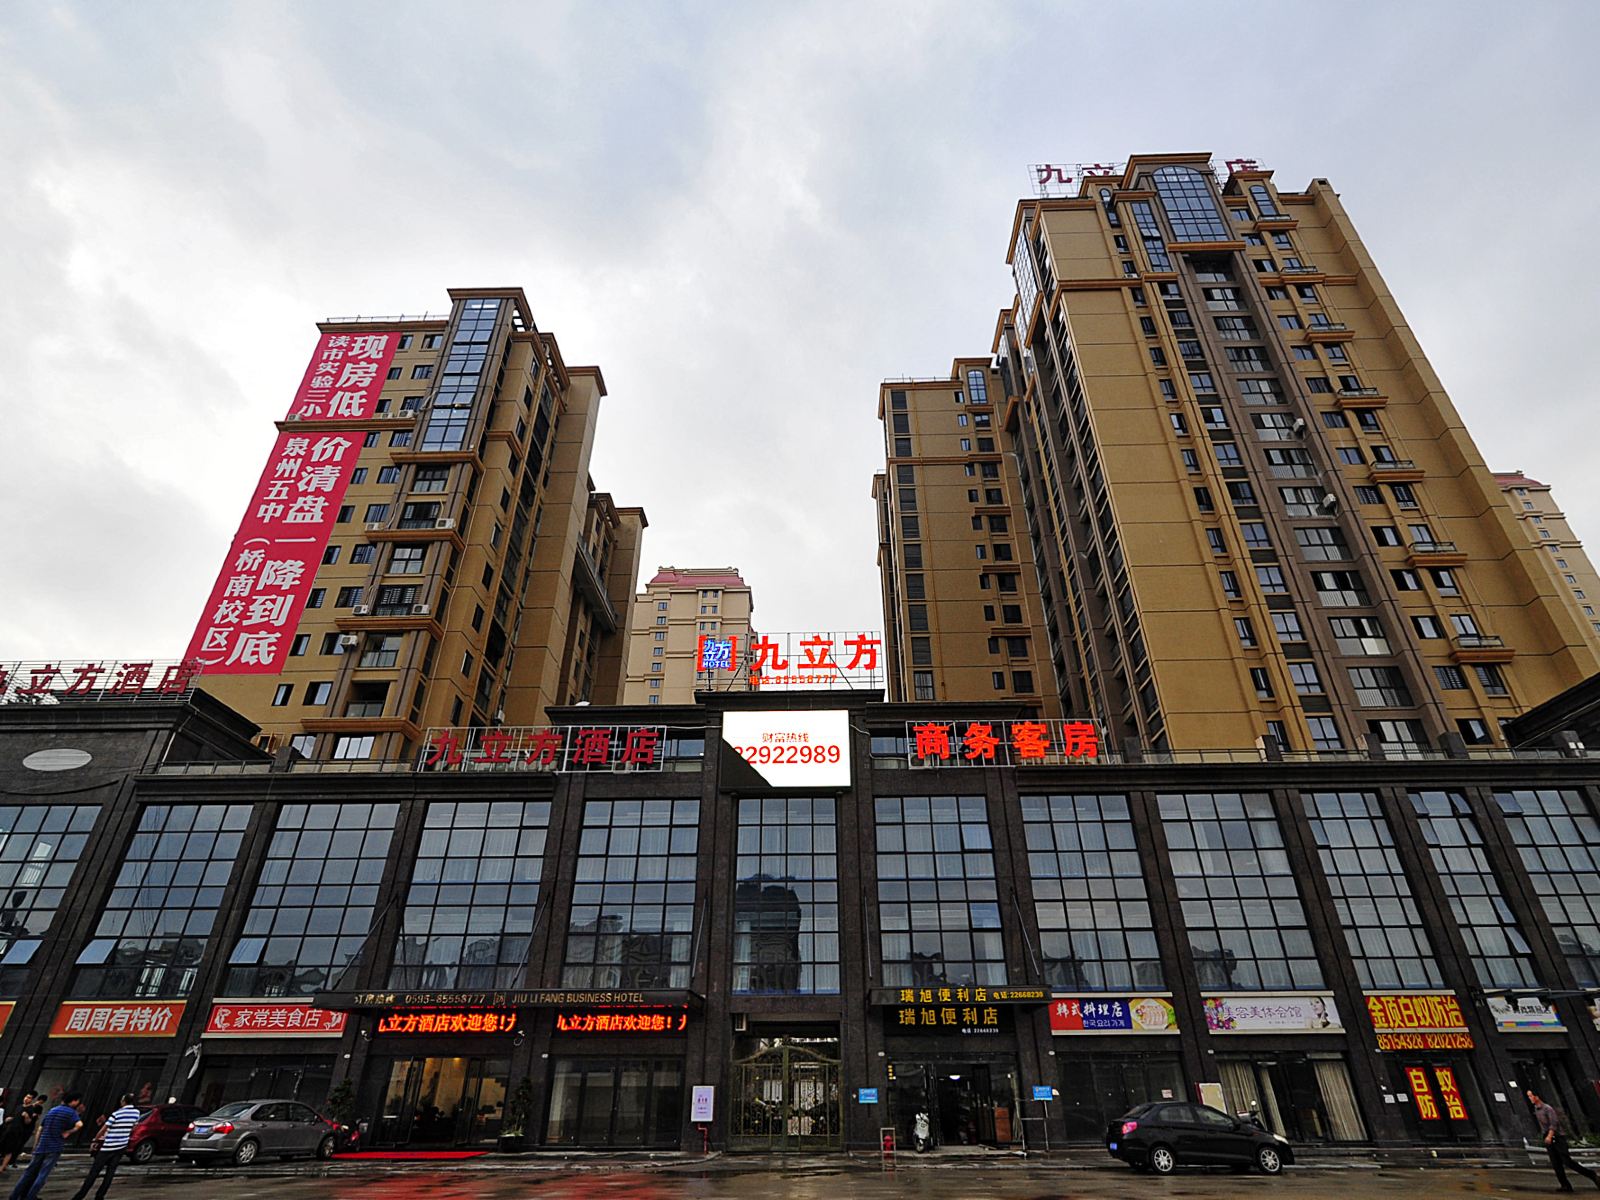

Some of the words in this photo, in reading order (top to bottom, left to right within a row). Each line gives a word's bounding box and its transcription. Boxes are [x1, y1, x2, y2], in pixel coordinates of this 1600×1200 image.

[749, 634, 882, 672] 九立方
[702, 660, 731, 668] HOTEL
[427, 729, 660, 766] 九立方酒店
[912, 721, 1100, 760] 商务客房
[512, 993, 527, 1004] JIU
[530, 993, 538, 1004] LI
[540, 993, 565, 1004] FANG
[567, 992, 612, 1003] BUSINESS
[614, 992, 645, 1003] HOTEL
[900, 987, 988, 1003] 瑞旭便利店
[233, 1008, 323, 1028] 家常美食店
[898, 1007, 998, 1025] 瑞旭便利店
[1056, 1001, 1124, 1018] 韩式料理店
[1367, 995, 1466, 1029] 金顶白蚁防治
[65, 1007, 174, 1032] 周周有特价
[1376, 1033, 1425, 1050] 85154328
[1426, 1033, 1475, 1049] 82021258
